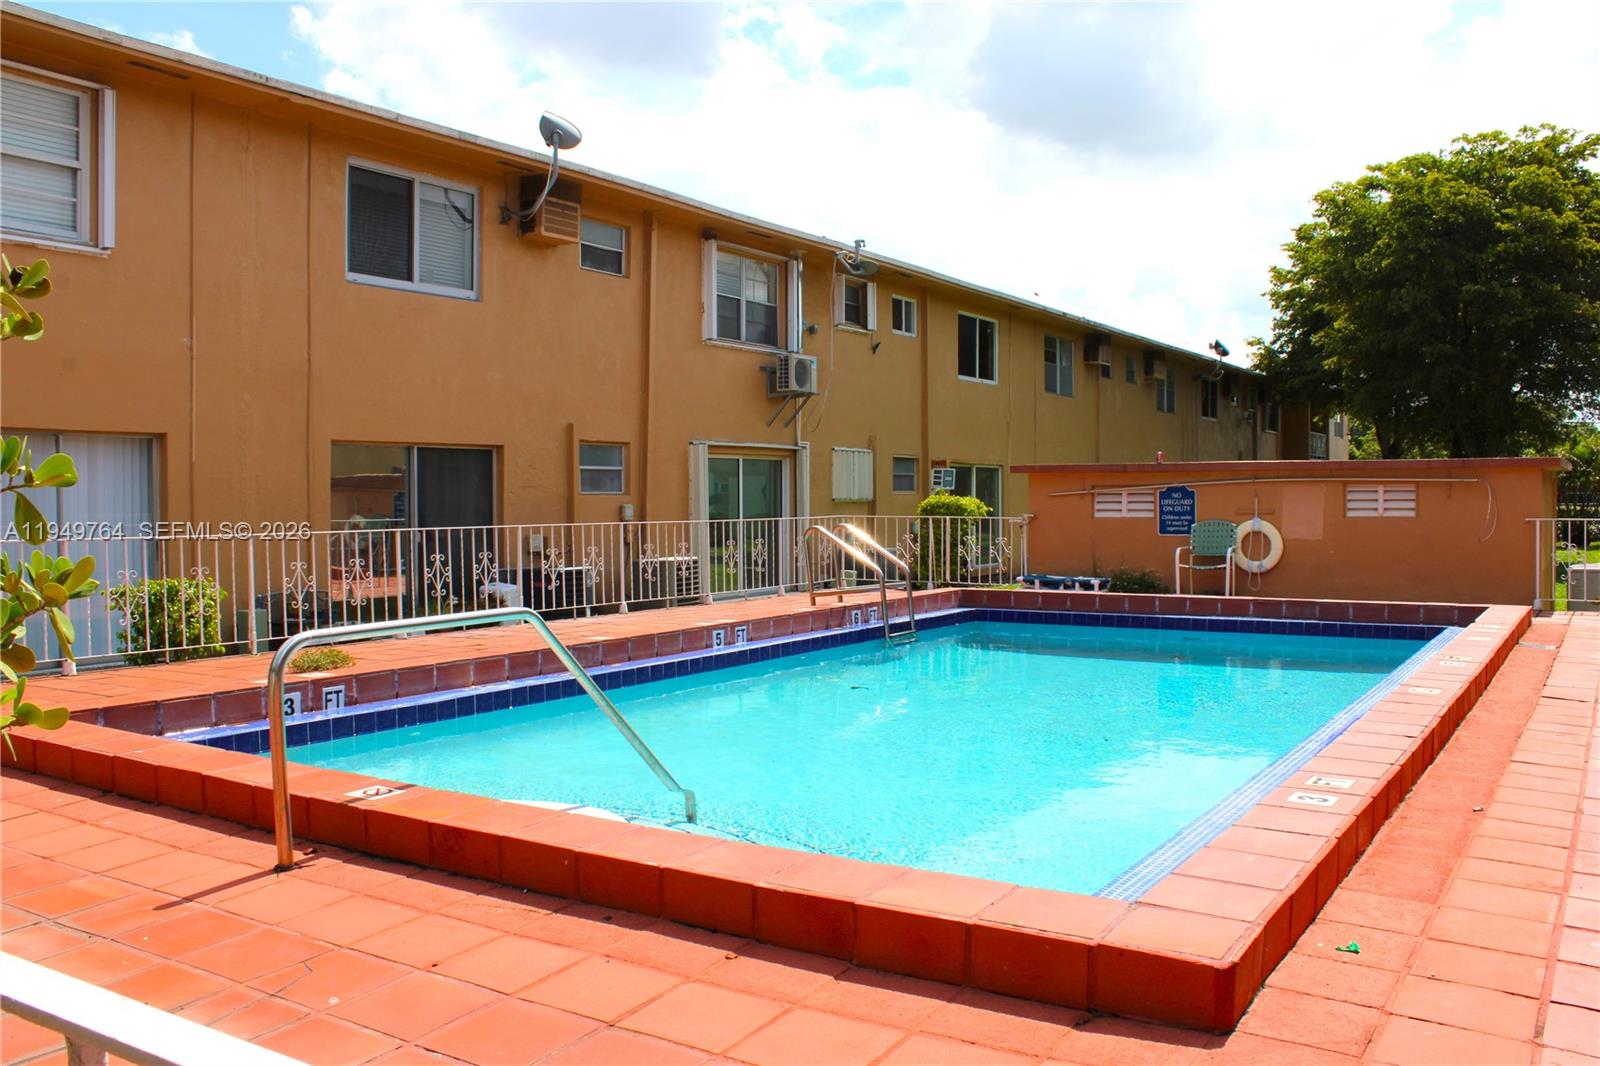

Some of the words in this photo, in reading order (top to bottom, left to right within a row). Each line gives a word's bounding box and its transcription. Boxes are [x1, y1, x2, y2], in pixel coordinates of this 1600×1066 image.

[854, 612, 859, 625] 6
[870, 609, 876, 621] FT
[716, 632, 722, 646] 5
[736, 628, 746, 643] FT
[283, 698, 295, 716] 3
[325, 689, 342, 710] FT
